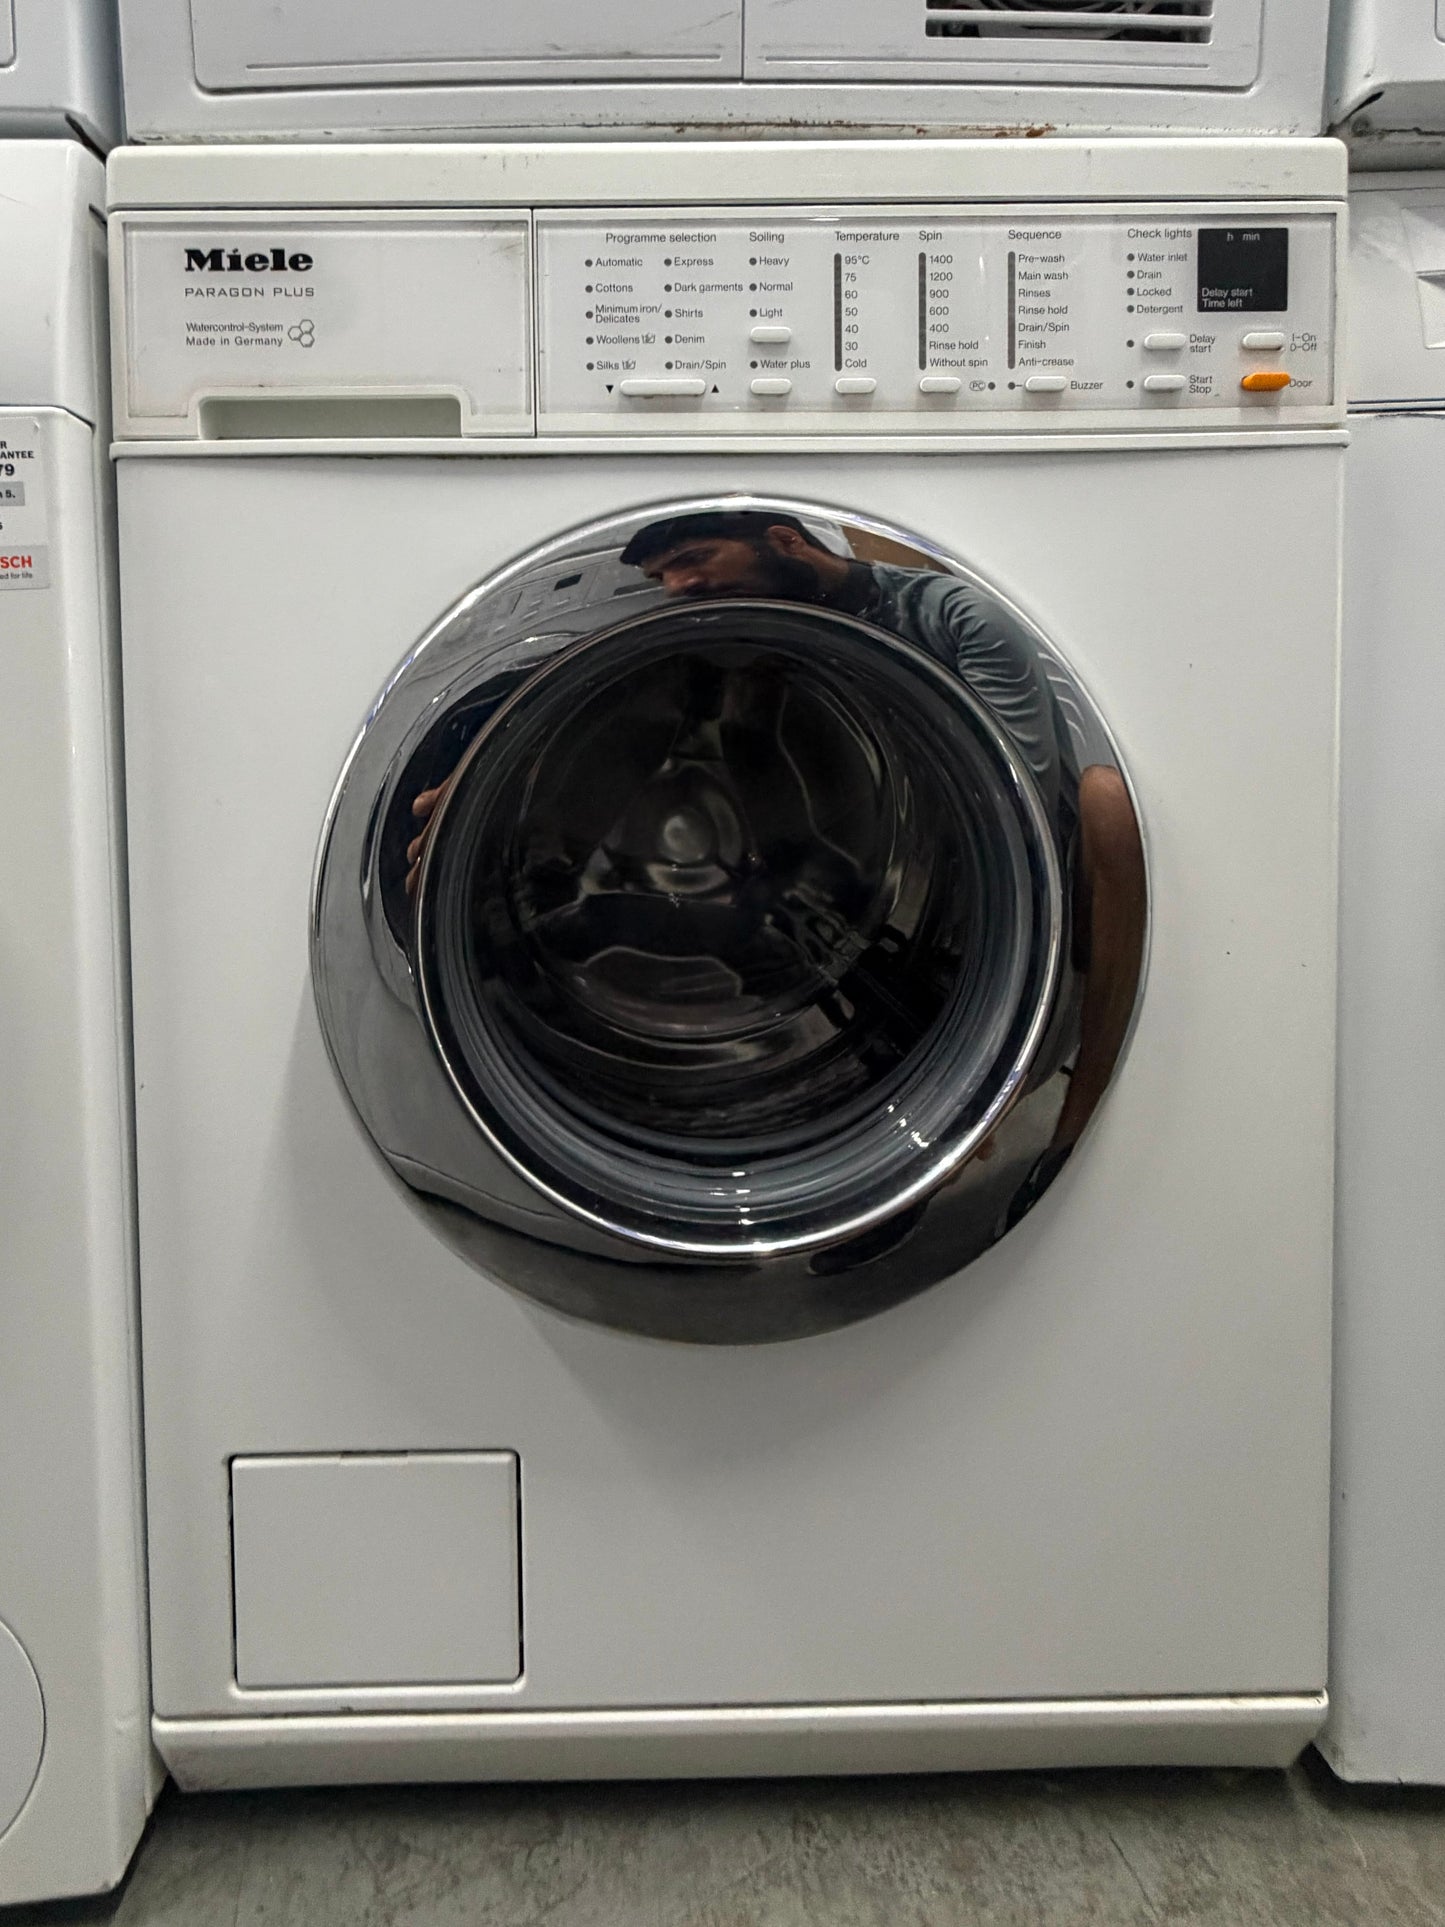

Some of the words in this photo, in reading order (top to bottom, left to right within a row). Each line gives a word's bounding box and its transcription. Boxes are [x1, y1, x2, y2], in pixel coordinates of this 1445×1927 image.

[605, 233, 666, 245] Programme
[669, 233, 716, 243] selection
[749, 232, 785, 244] Soiling
[835, 231, 900, 242] Temperature
[919, 231, 943, 242] Spin
[1008, 230, 1062, 241] Sequence
[1127, 229, 1161, 239] Check
[1164, 229, 1192, 240] lights
[1242, 232, 1260, 241] min
[184, 248, 313, 272] Miele
[759, 257, 789, 267] Heavy
[845, 255, 870, 265] 95°C
[929, 255, 953, 264] 1400
[1018, 254, 1065, 263] Pre-wash
[1137, 253, 1164, 262] Water
[1168, 253, 1188, 262] inlet
[595, 258, 643, 267] Automatic
[674, 257, 714, 268] Express
[845, 273, 857, 282] 75
[929, 272, 953, 281] 1200
[1018, 272, 1041, 280] Main
[1044, 272, 1069, 280] wash
[1137, 270, 1162, 279] Drain
[595, 284, 633, 292] Cottons
[675, 283, 697, 291] Dark
[699, 283, 743, 294] garments
[760, 282, 793, 291] Normal
[185, 288, 264, 297] PARAGON
[273, 288, 315, 297] PLUS
[845, 290, 858, 299] 60
[929, 289, 949, 298] 900
[1018, 289, 1051, 298] Rinses
[1137, 287, 1172, 296] Locked
[1202, 288, 1228, 299] Delay
[1231, 288, 1253, 297] start
[1203, 299, 1225, 308] Time
[1227, 299, 1243, 308] left
[595, 305, 640, 314] Minimum
[675, 309, 704, 318] Shirts
[760, 308, 783, 319] Light
[845, 307, 858, 317] 50
[929, 306, 949, 316] 600
[1018, 306, 1045, 315] Rinse
[1047, 305, 1068, 315] hold
[1137, 305, 1183, 315] Detergent
[595, 314, 640, 323] Delicates
[186, 322, 284, 333] Watercontrol-System
[845, 324, 859, 334] 40
[929, 324, 949, 333] 400
[1018, 323, 1070, 333] Drain/Spin
[186, 337, 215, 346] Made
[220, 336, 229, 345] in
[234, 336, 283, 347] Germany
[596, 335, 640, 344] Woollens
[675, 335, 705, 344] Denim
[1190, 334, 1216, 345] Delay
[845, 341, 858, 351] 30
[929, 341, 957, 350] Rinse
[958, 341, 979, 350] hold
[1018, 340, 1046, 349] Finish
[1190, 344, 1212, 353] start
[596, 361, 619, 370] Silks
[675, 360, 727, 371] Drain/Spin
[760, 360, 787, 369] Water
[790, 360, 811, 371] plus
[845, 359, 867, 368] Cold
[929, 358, 967, 367] Without
[968, 358, 988, 369] spin
[1018, 357, 1074, 366] Anti-crease
[1189, 375, 1212, 384] Start
[1071, 381, 1103, 390] Buzzer
[1188, 385, 1212, 394] Stop
